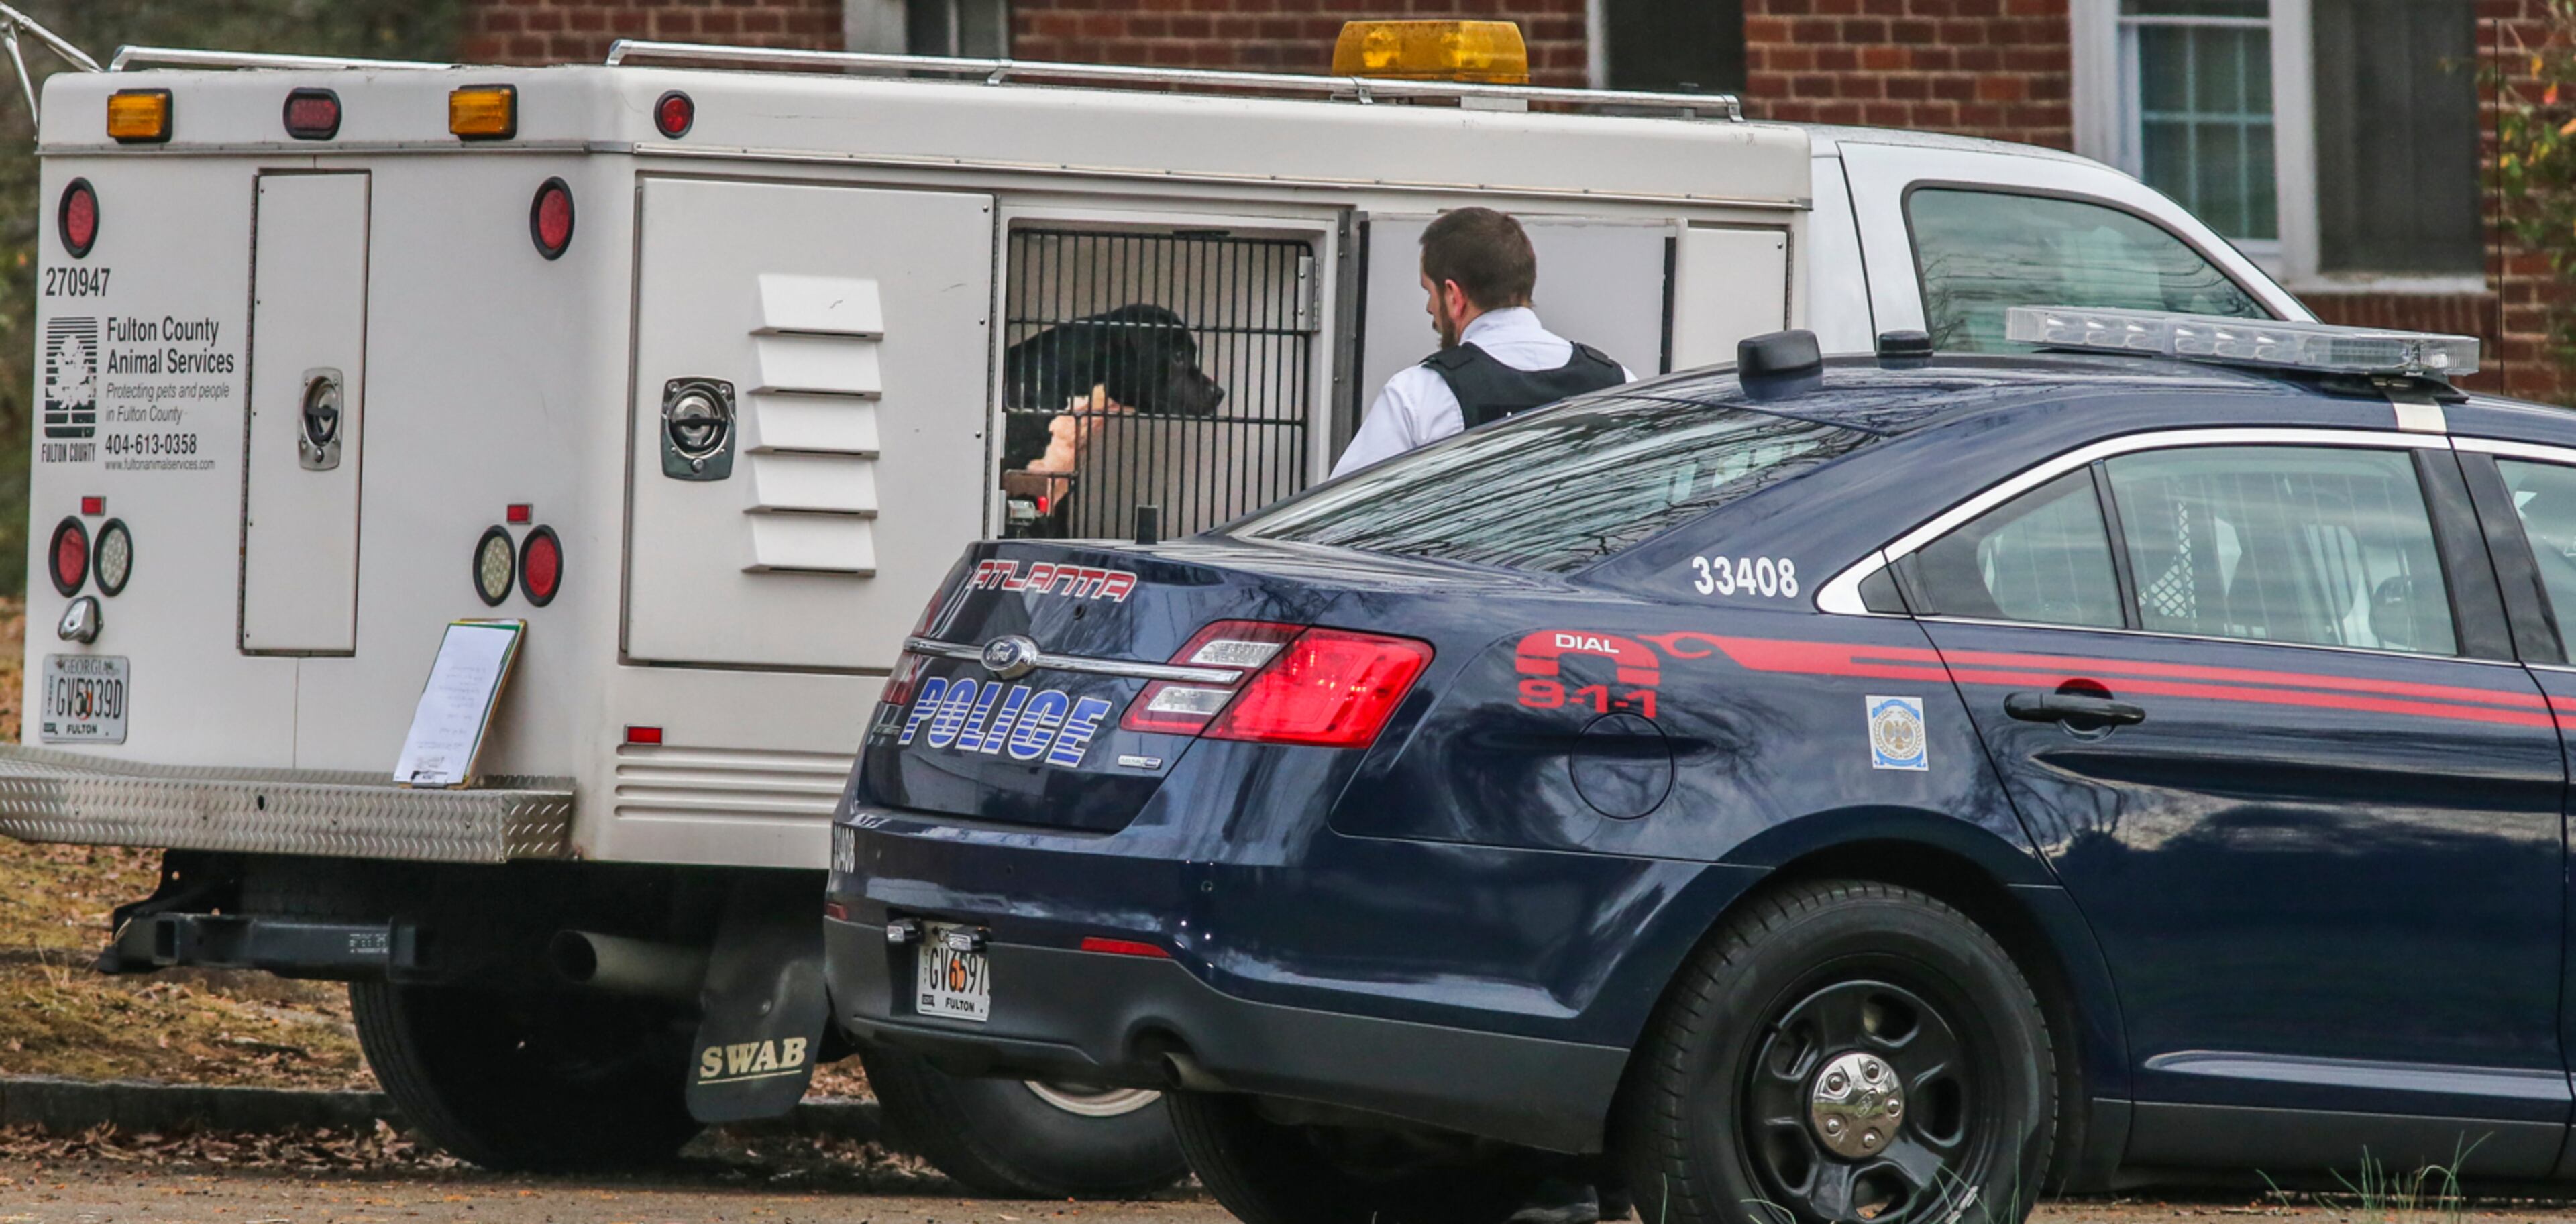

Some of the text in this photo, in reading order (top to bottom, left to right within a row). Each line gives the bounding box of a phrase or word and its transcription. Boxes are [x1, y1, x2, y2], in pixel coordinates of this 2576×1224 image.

[45, 267, 111, 297] 270947
[107, 315, 219, 347] Fulton County
[107, 347, 235, 374] Animal Services
[106, 381, 230, 404] Protecting pets and people
[105, 404, 183, 425] in Fulton County
[41, 443, 96, 463] FULTON COUNTY
[105, 433, 197, 455] 404-613-0358
[105, 458, 216, 471] www.fultonanimalservices.com
[966, 559, 1138, 602] ATLANTA
[1691, 555, 1799, 598] 33408
[1554, 632, 1620, 654] DIAL
[63, 659, 113, 676] GEORGIA
[56, 677, 123, 720] GV5039D
[1517, 678, 1657, 719] 9-1-1
[66, 724, 97, 734] FULTON
[897, 677, 1112, 768] POLICE
[945, 997, 975, 1013] FULTON
[699, 1037, 808, 1078] SWAB
